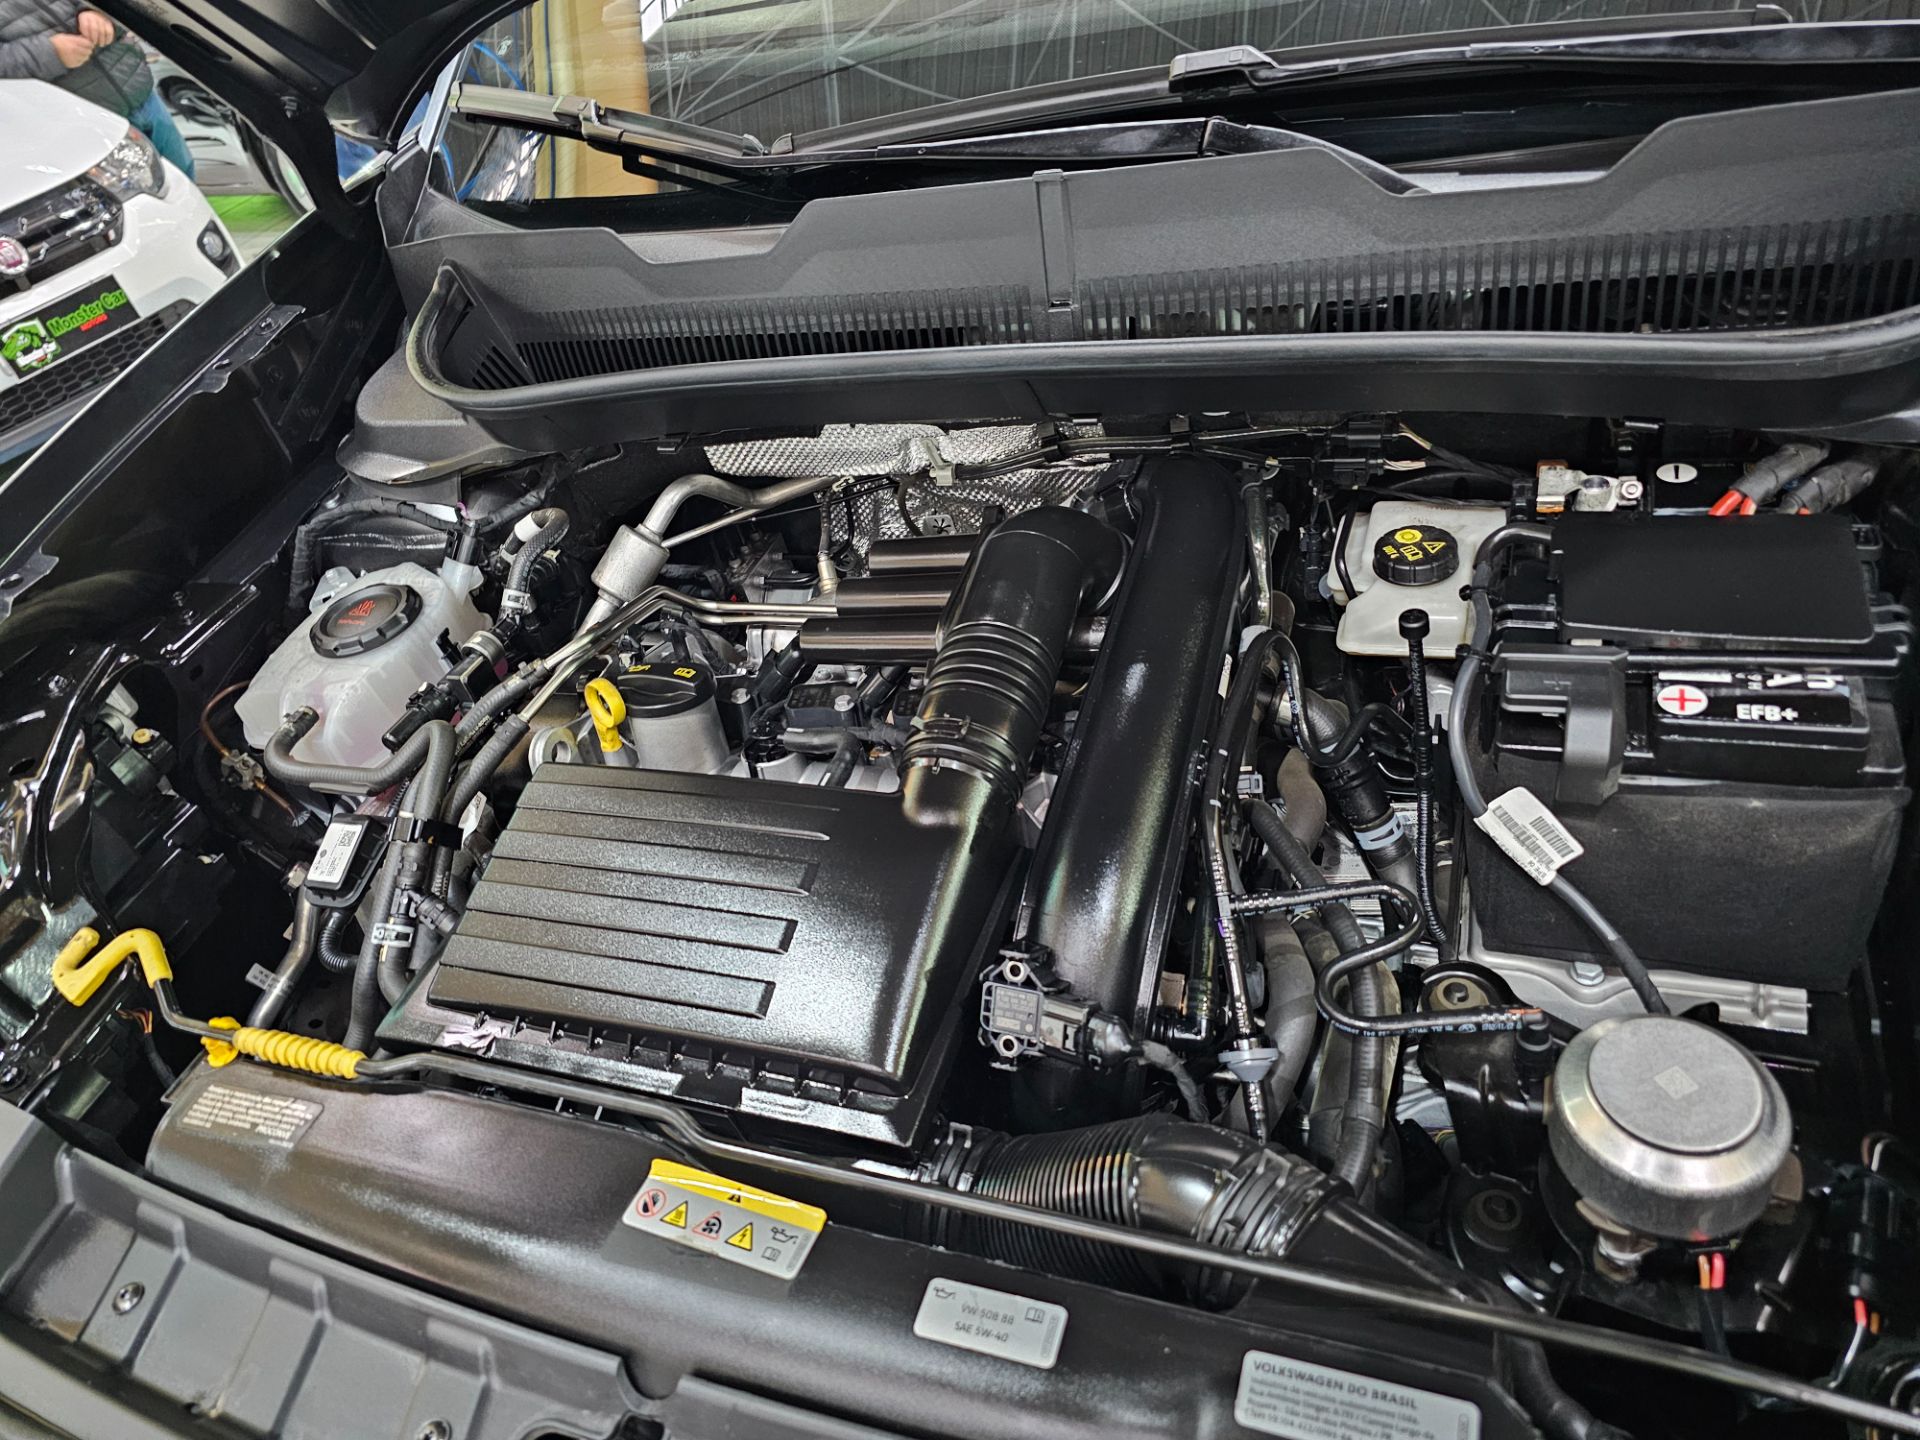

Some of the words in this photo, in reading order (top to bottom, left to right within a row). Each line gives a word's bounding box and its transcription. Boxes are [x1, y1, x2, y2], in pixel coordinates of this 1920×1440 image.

[46, 300, 104, 337] Monster
[100, 289, 127, 310] Car
[1737, 703, 1799, 722] EFB+
[961, 1302, 978, 1316] VW
[954, 1320, 973, 1334] SAE
[975, 1326, 1009, 1343] 5W-40
[1253, 1359, 1344, 1391] VOLKSWAGEN
[1347, 1383, 1368, 1396] DO
[1371, 1388, 1418, 1409] BRASIL
